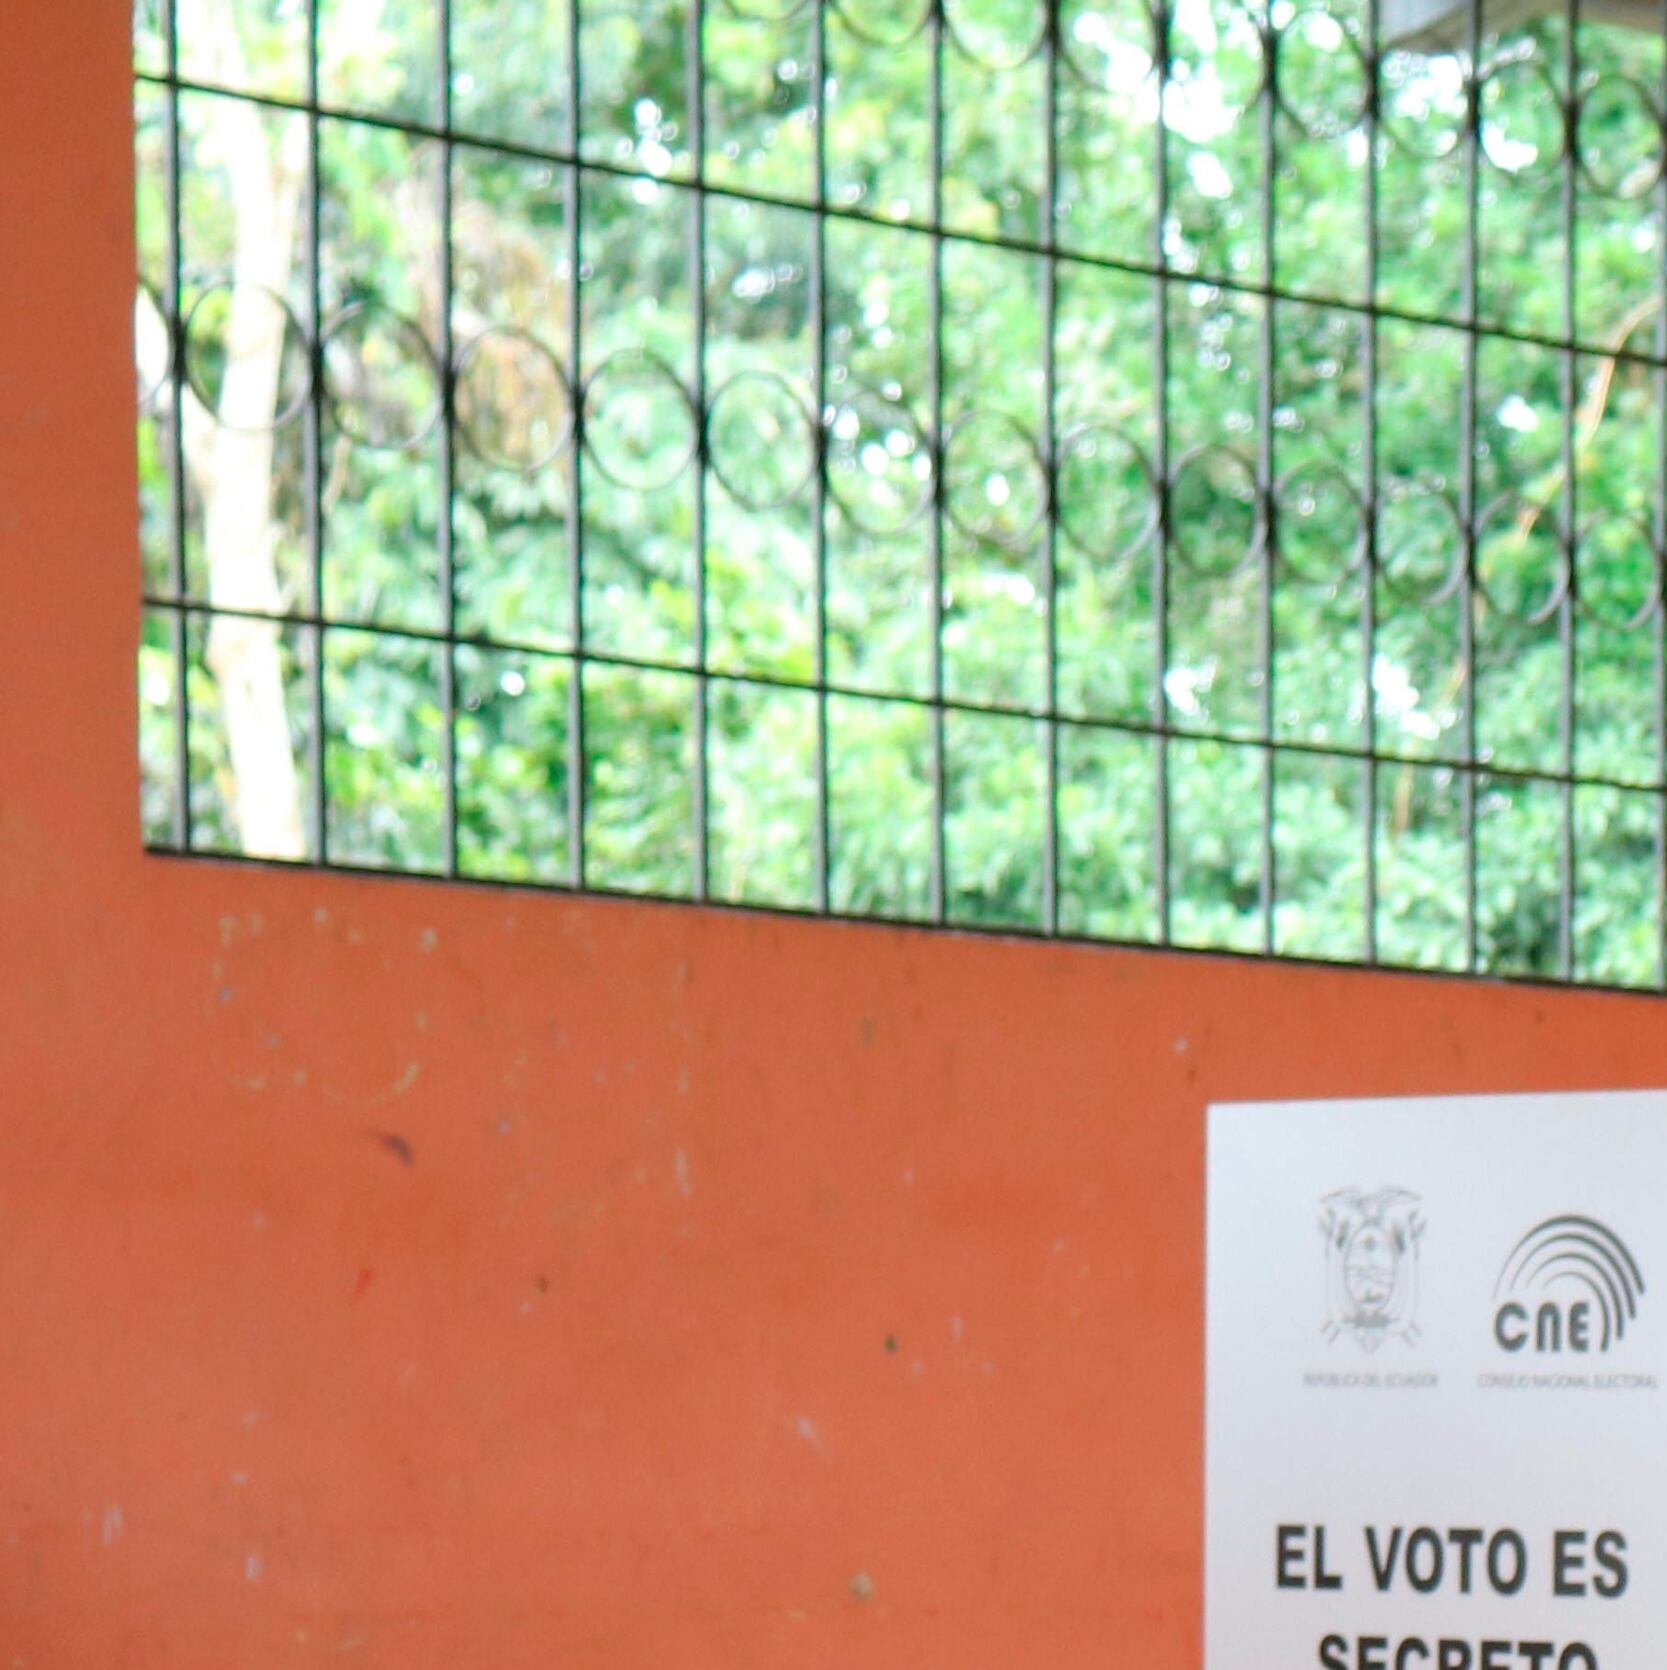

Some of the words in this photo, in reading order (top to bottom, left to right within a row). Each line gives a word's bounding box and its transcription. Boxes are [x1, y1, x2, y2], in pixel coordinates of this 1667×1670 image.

[1275, 1524, 1343, 1590] EL
[1363, 1525, 1529, 1596] VOTO
[1552, 1529, 1629, 1598] ES
